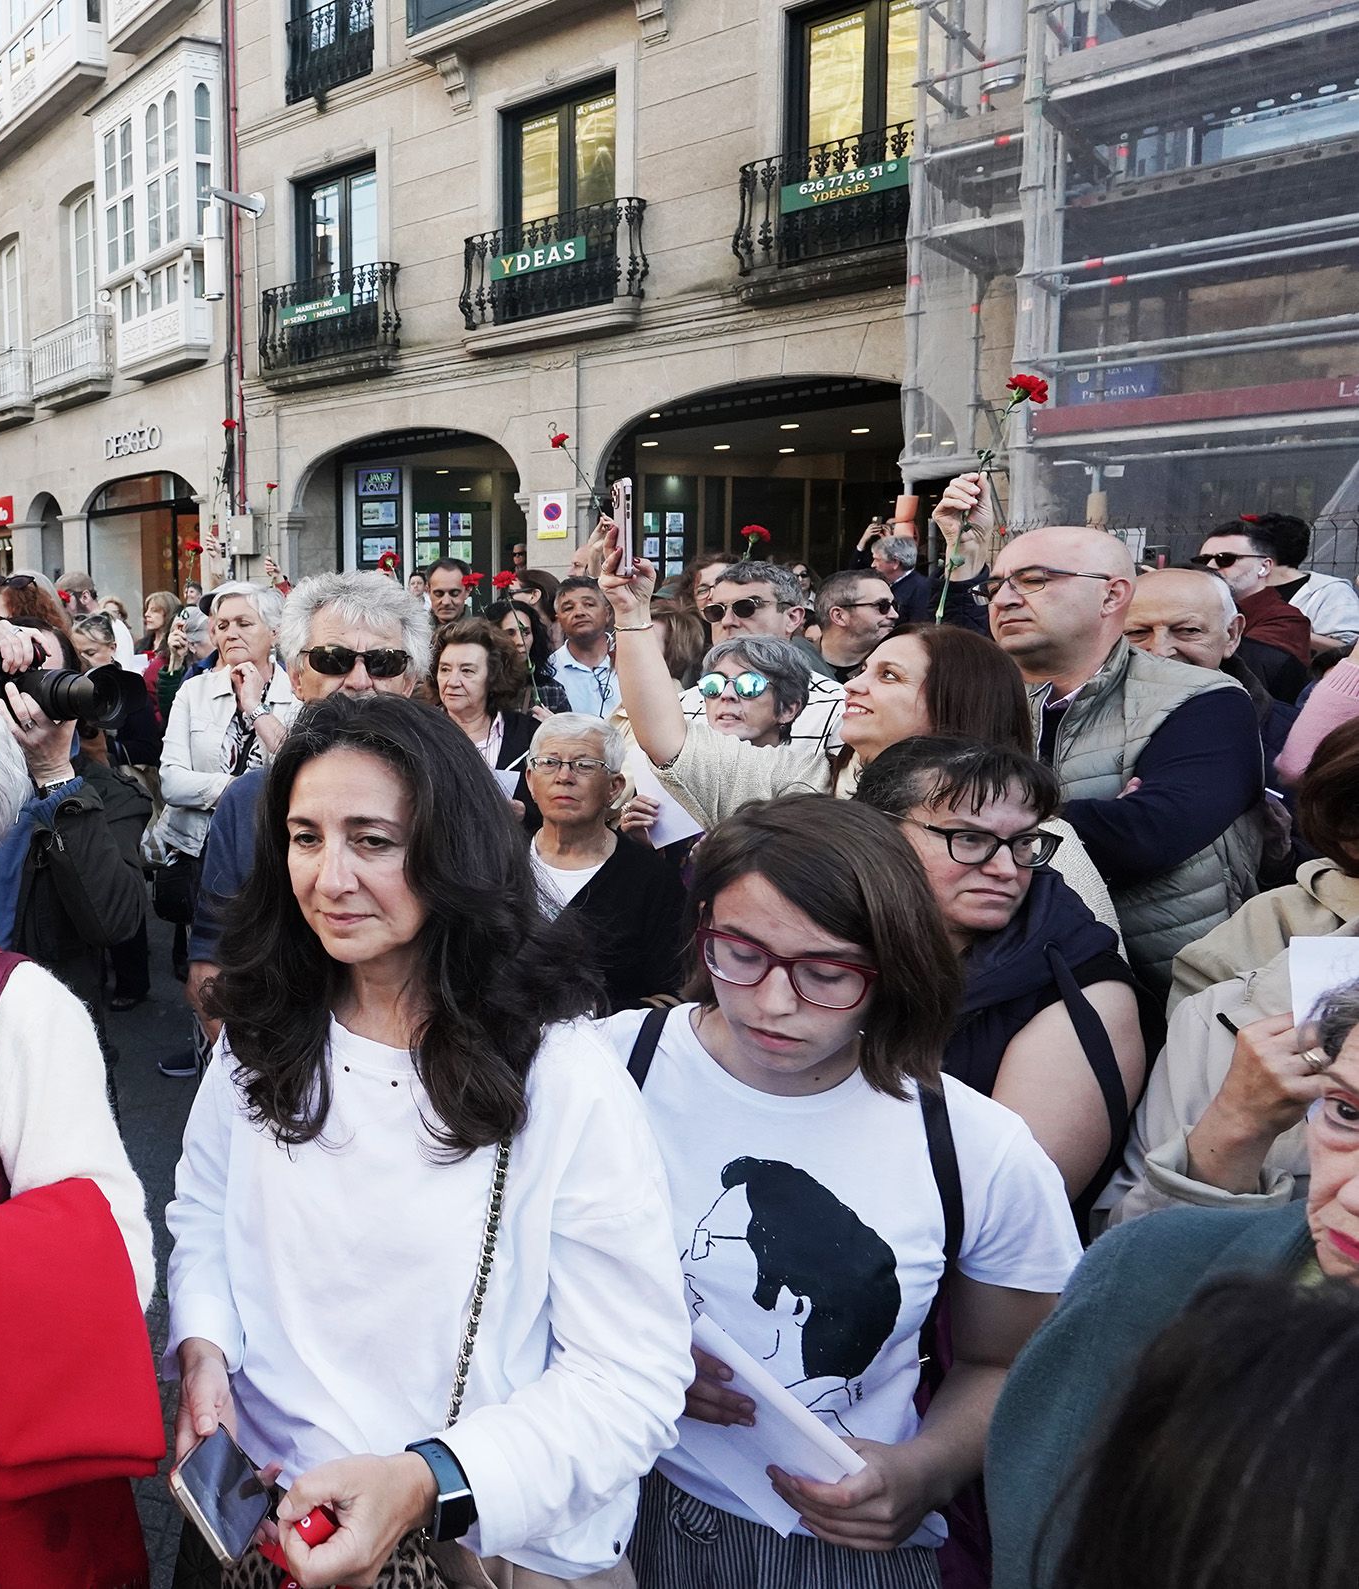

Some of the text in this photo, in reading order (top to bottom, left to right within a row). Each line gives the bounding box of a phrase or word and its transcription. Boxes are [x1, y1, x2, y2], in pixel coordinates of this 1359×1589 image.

[799, 165, 883, 195] 626 77 36 31
[812, 181, 870, 203] YDEAS.ES
[500, 242, 576, 275] YDEAS
[1082, 384, 1145, 400] PEEGRINA
